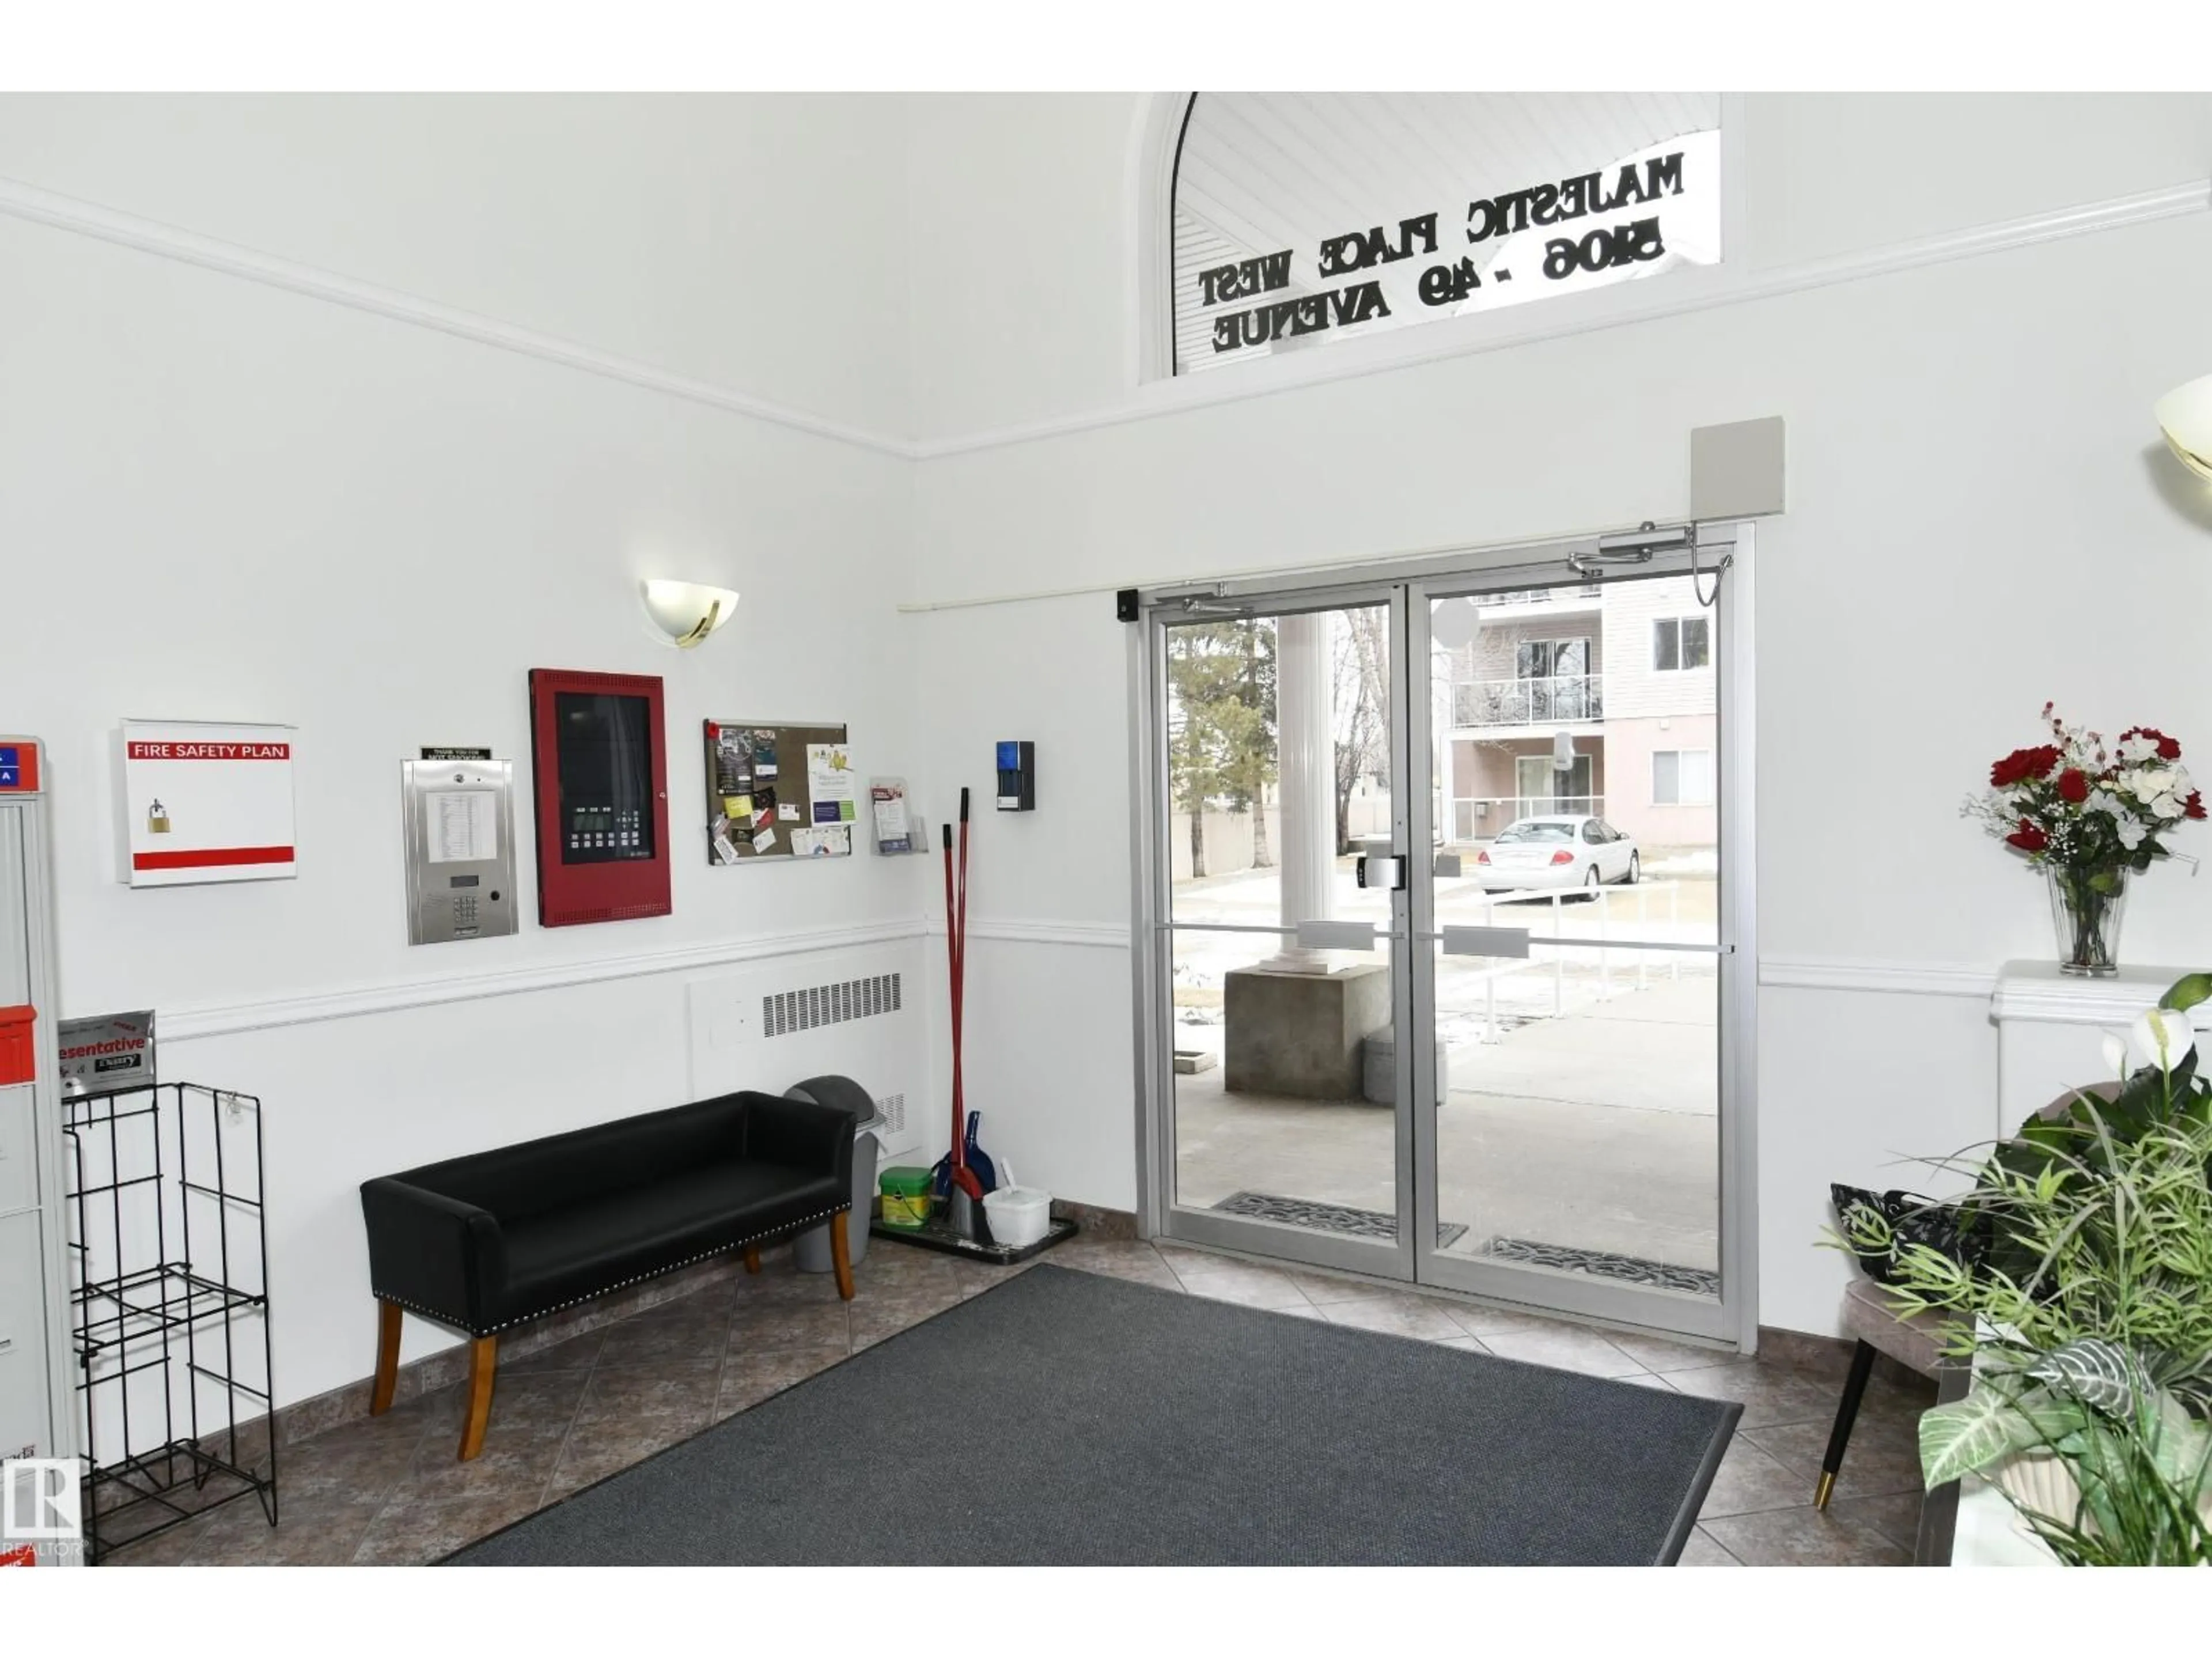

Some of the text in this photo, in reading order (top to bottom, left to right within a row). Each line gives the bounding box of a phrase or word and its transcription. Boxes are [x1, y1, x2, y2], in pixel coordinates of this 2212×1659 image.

[134, 744, 285, 757] FIRE SAFETY PLAN
